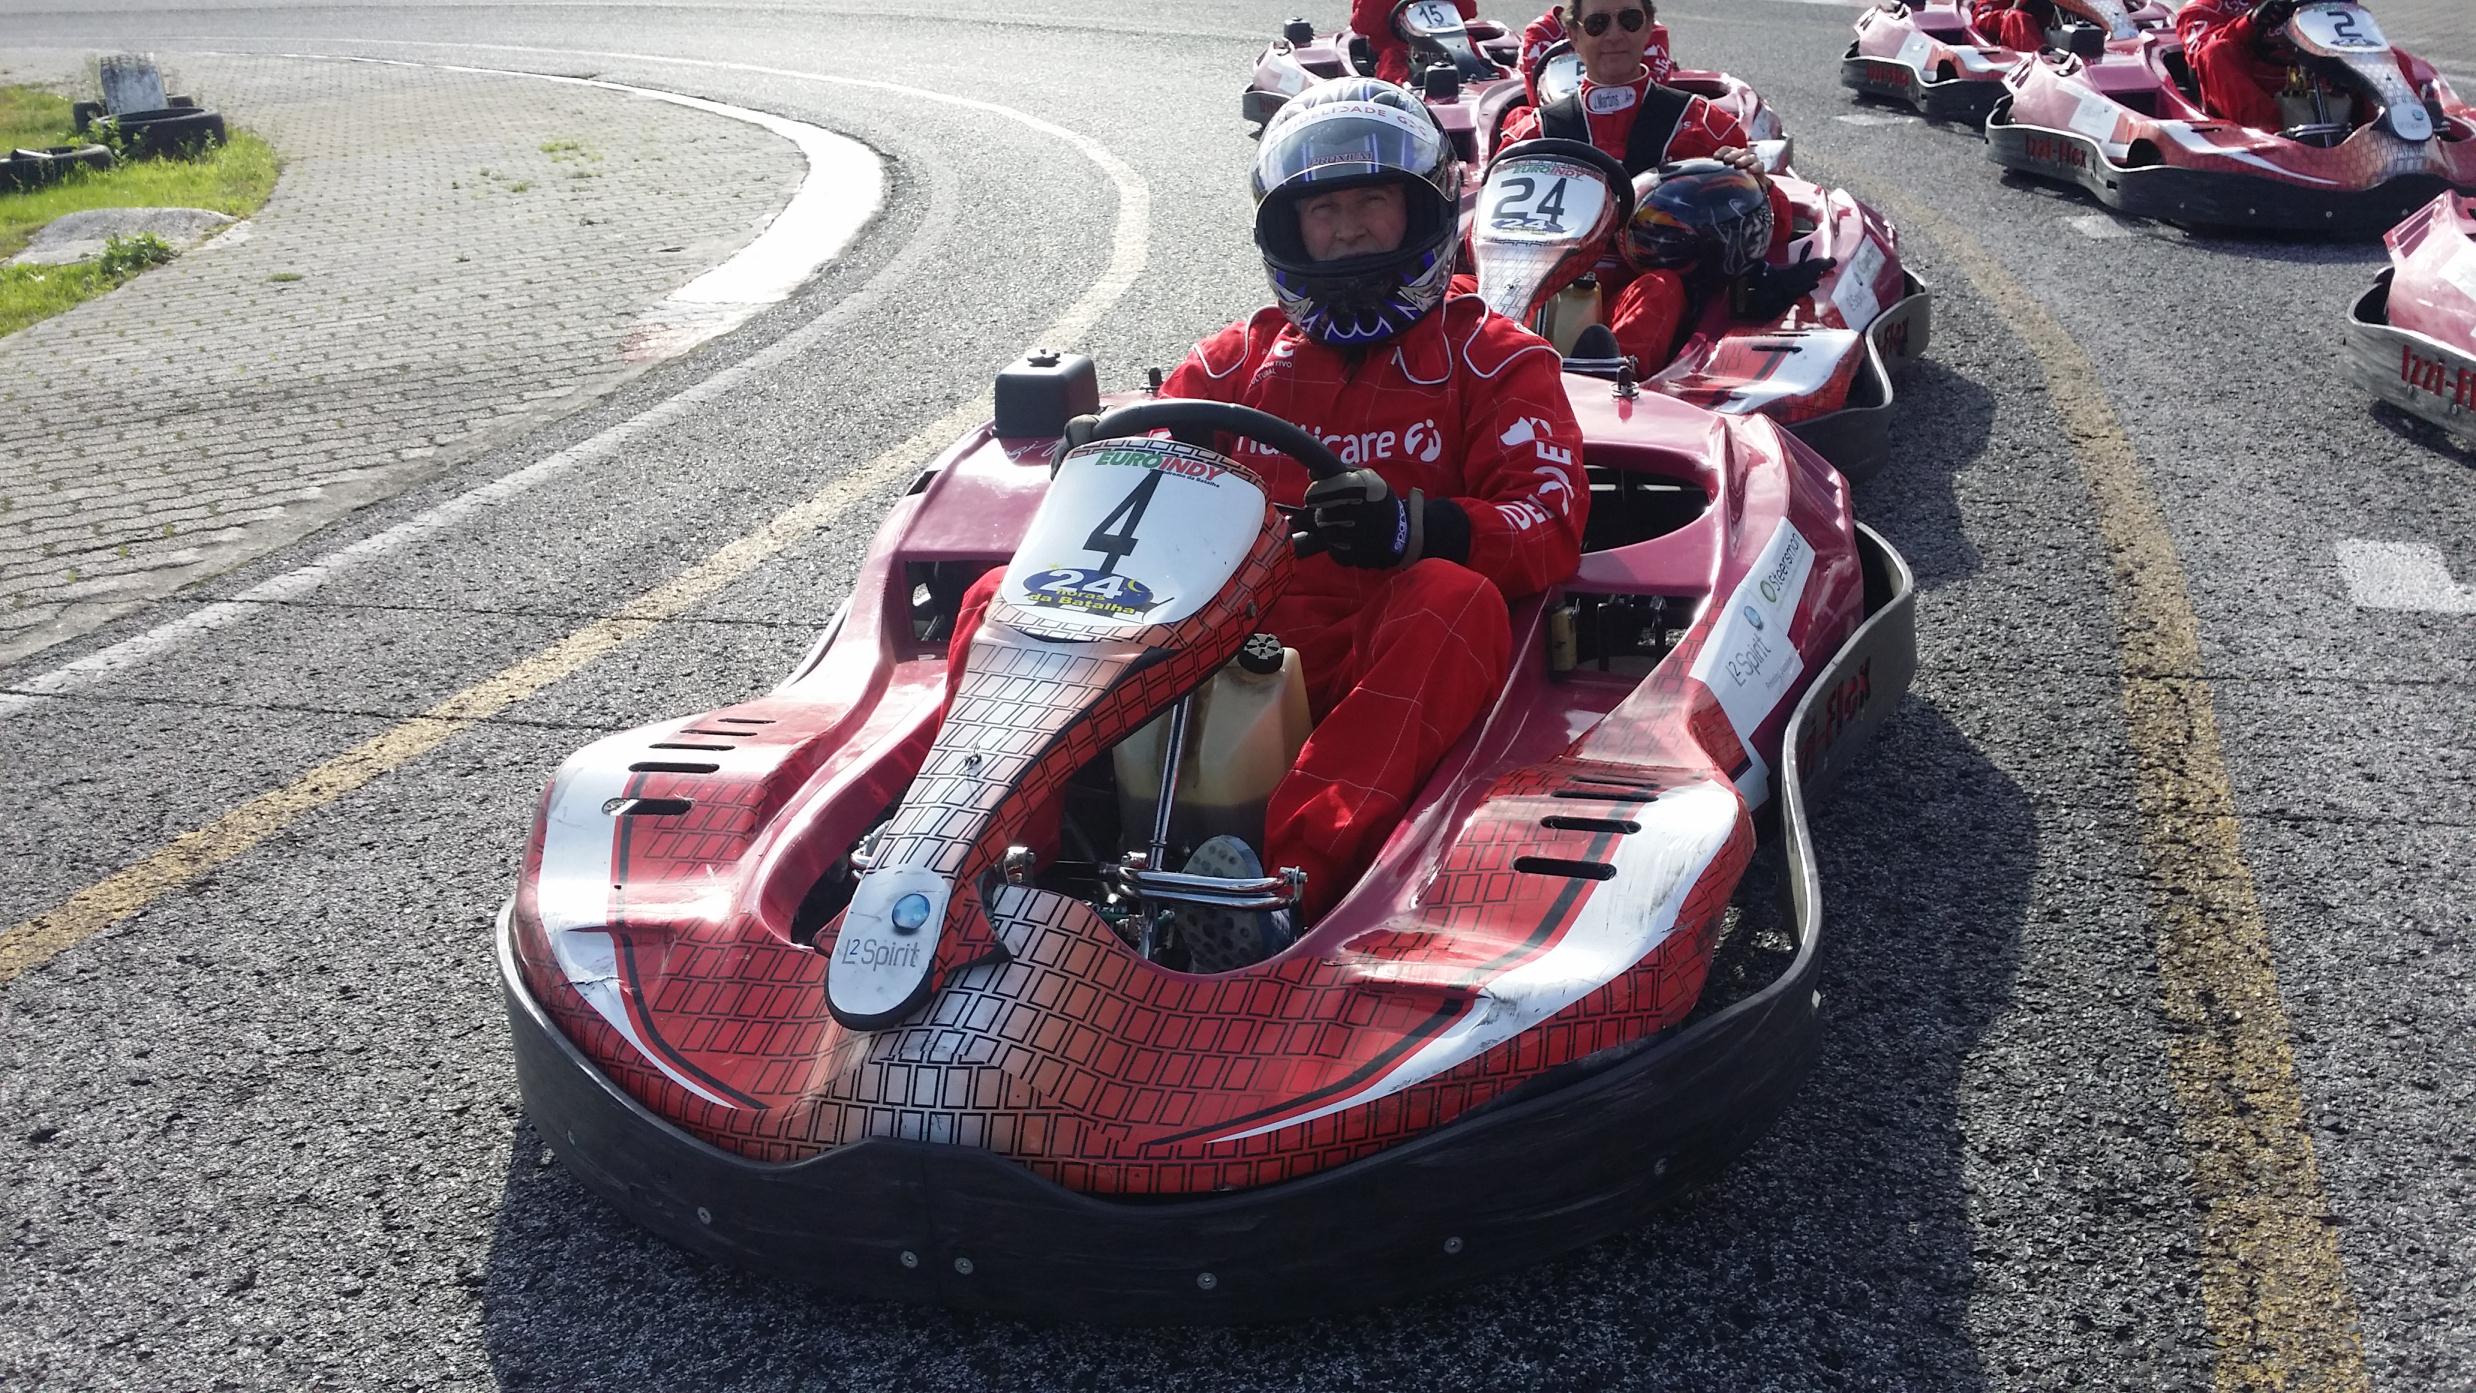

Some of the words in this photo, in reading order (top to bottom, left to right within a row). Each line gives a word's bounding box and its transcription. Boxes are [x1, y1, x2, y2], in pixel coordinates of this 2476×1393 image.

[1419, 5, 1445, 25] 15
[2326, 11, 2363, 38] 2
[1491, 177, 1567, 225] 24
[1251, 368, 1276, 385] ULTURAL
[1095, 451, 1226, 481] EUROINDY
[1082, 468, 1163, 575] 4
[1771, 532, 1802, 591] Steersman
[1040, 569, 1124, 599] 24
[1028, 593, 1052, 602] da
[1059, 596, 1136, 615] Batalha
[861, 938, 920, 972] Spirit
